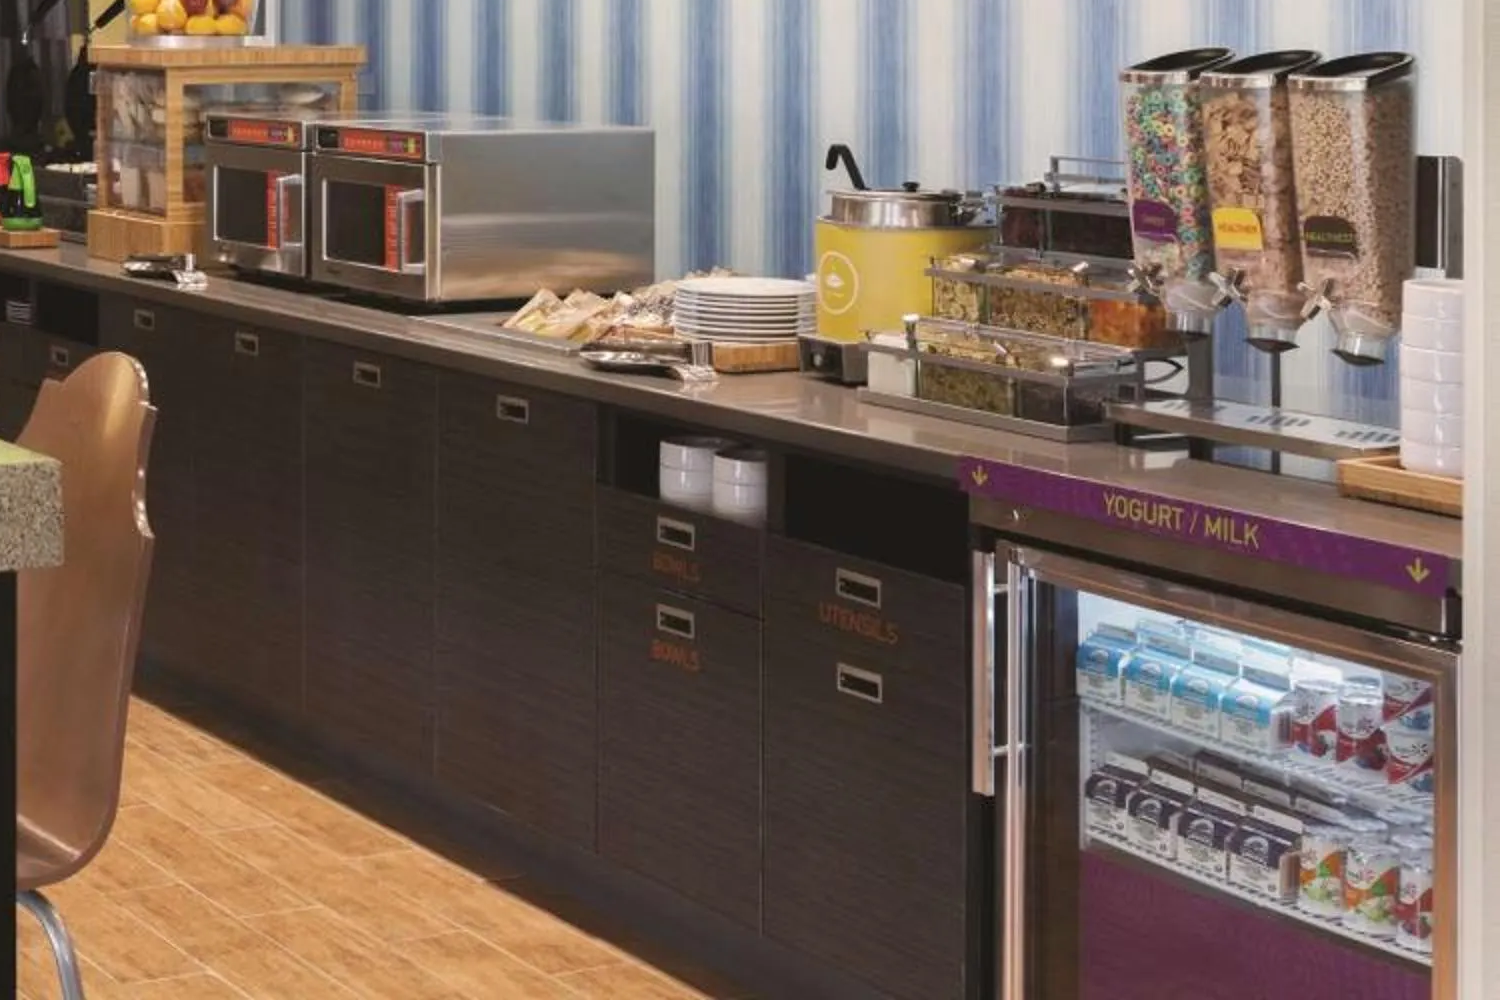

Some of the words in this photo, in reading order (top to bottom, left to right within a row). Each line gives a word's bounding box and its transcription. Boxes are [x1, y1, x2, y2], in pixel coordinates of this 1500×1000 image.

[1103, 493, 1185, 532] YOGURT
[1189, 513, 1199, 535] /
[1204, 516, 1260, 550] MILK
[818, 602, 899, 645] UTENSILS
